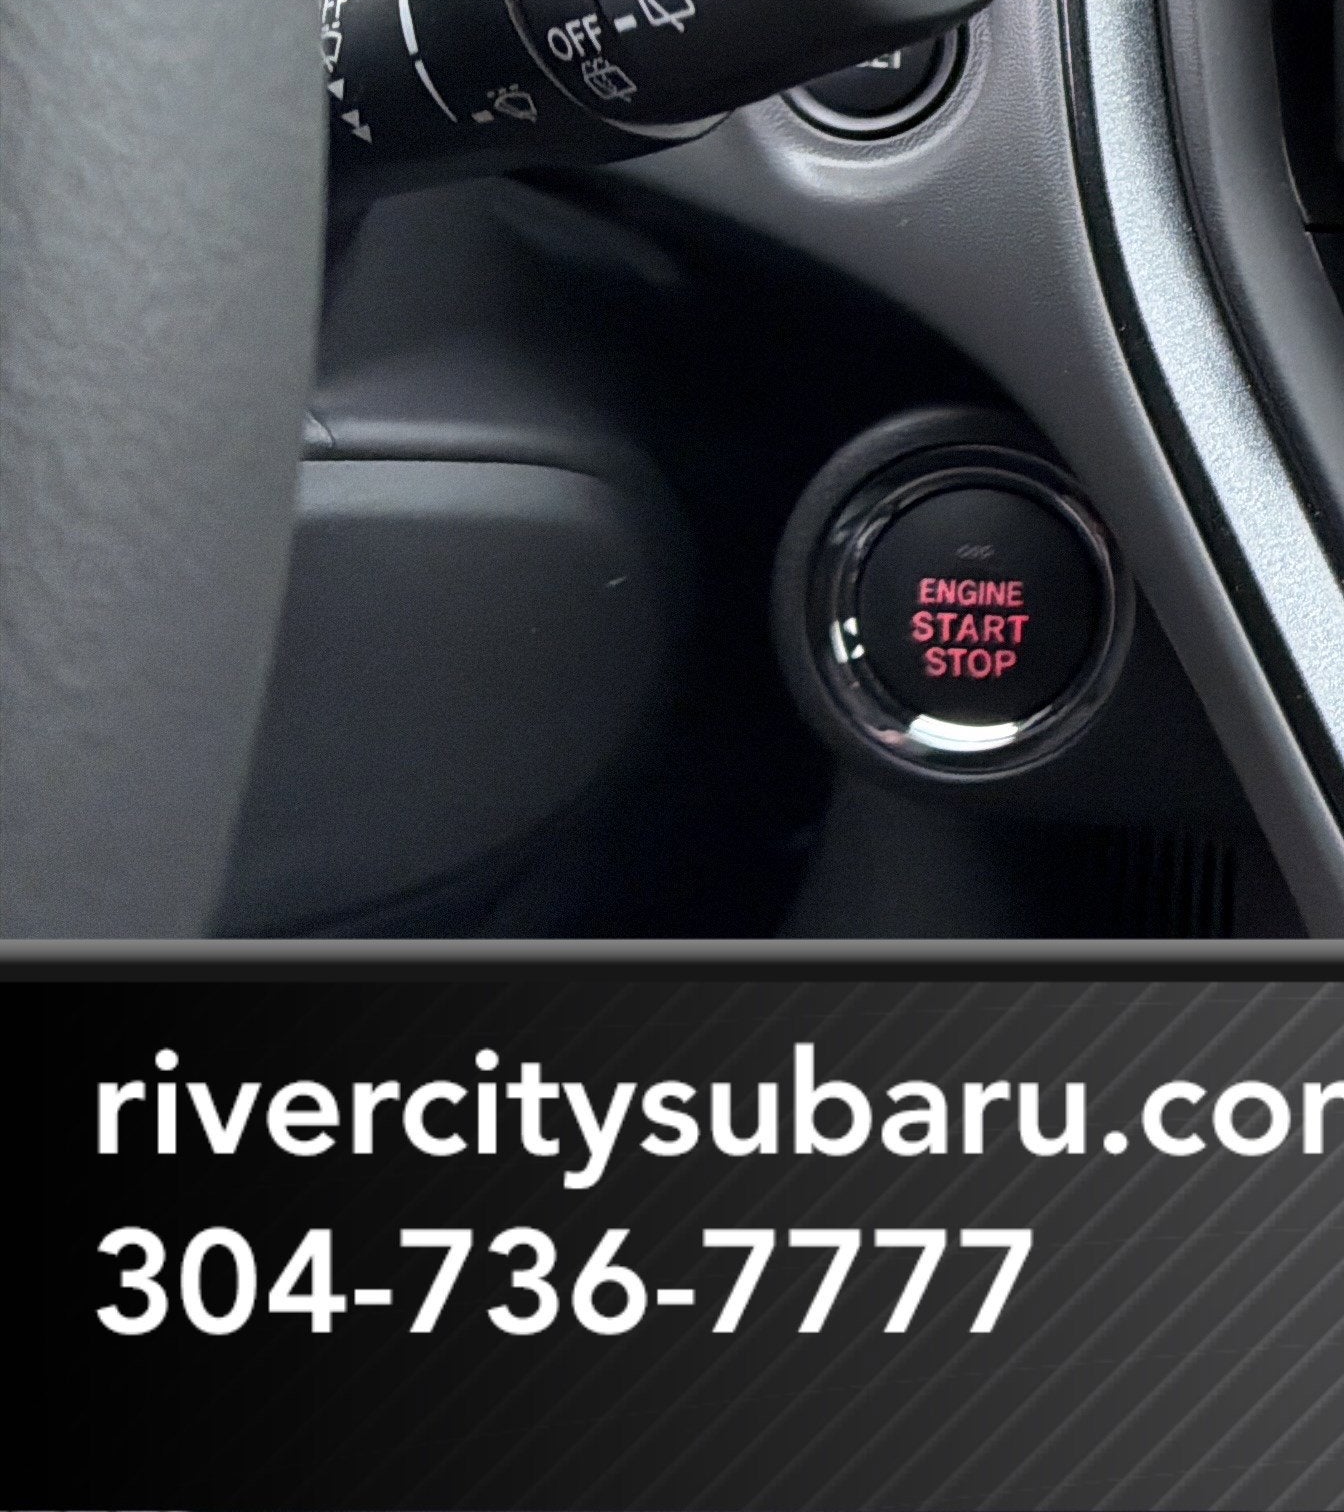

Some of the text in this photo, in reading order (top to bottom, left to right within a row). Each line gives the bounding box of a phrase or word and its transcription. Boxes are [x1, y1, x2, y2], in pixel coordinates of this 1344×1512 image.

[547, 13, 602, 61] OFF
[918, 577, 1024, 606] ENGINE
[911, 611, 1030, 643] START
[924, 647, 1018, 678] STOP
